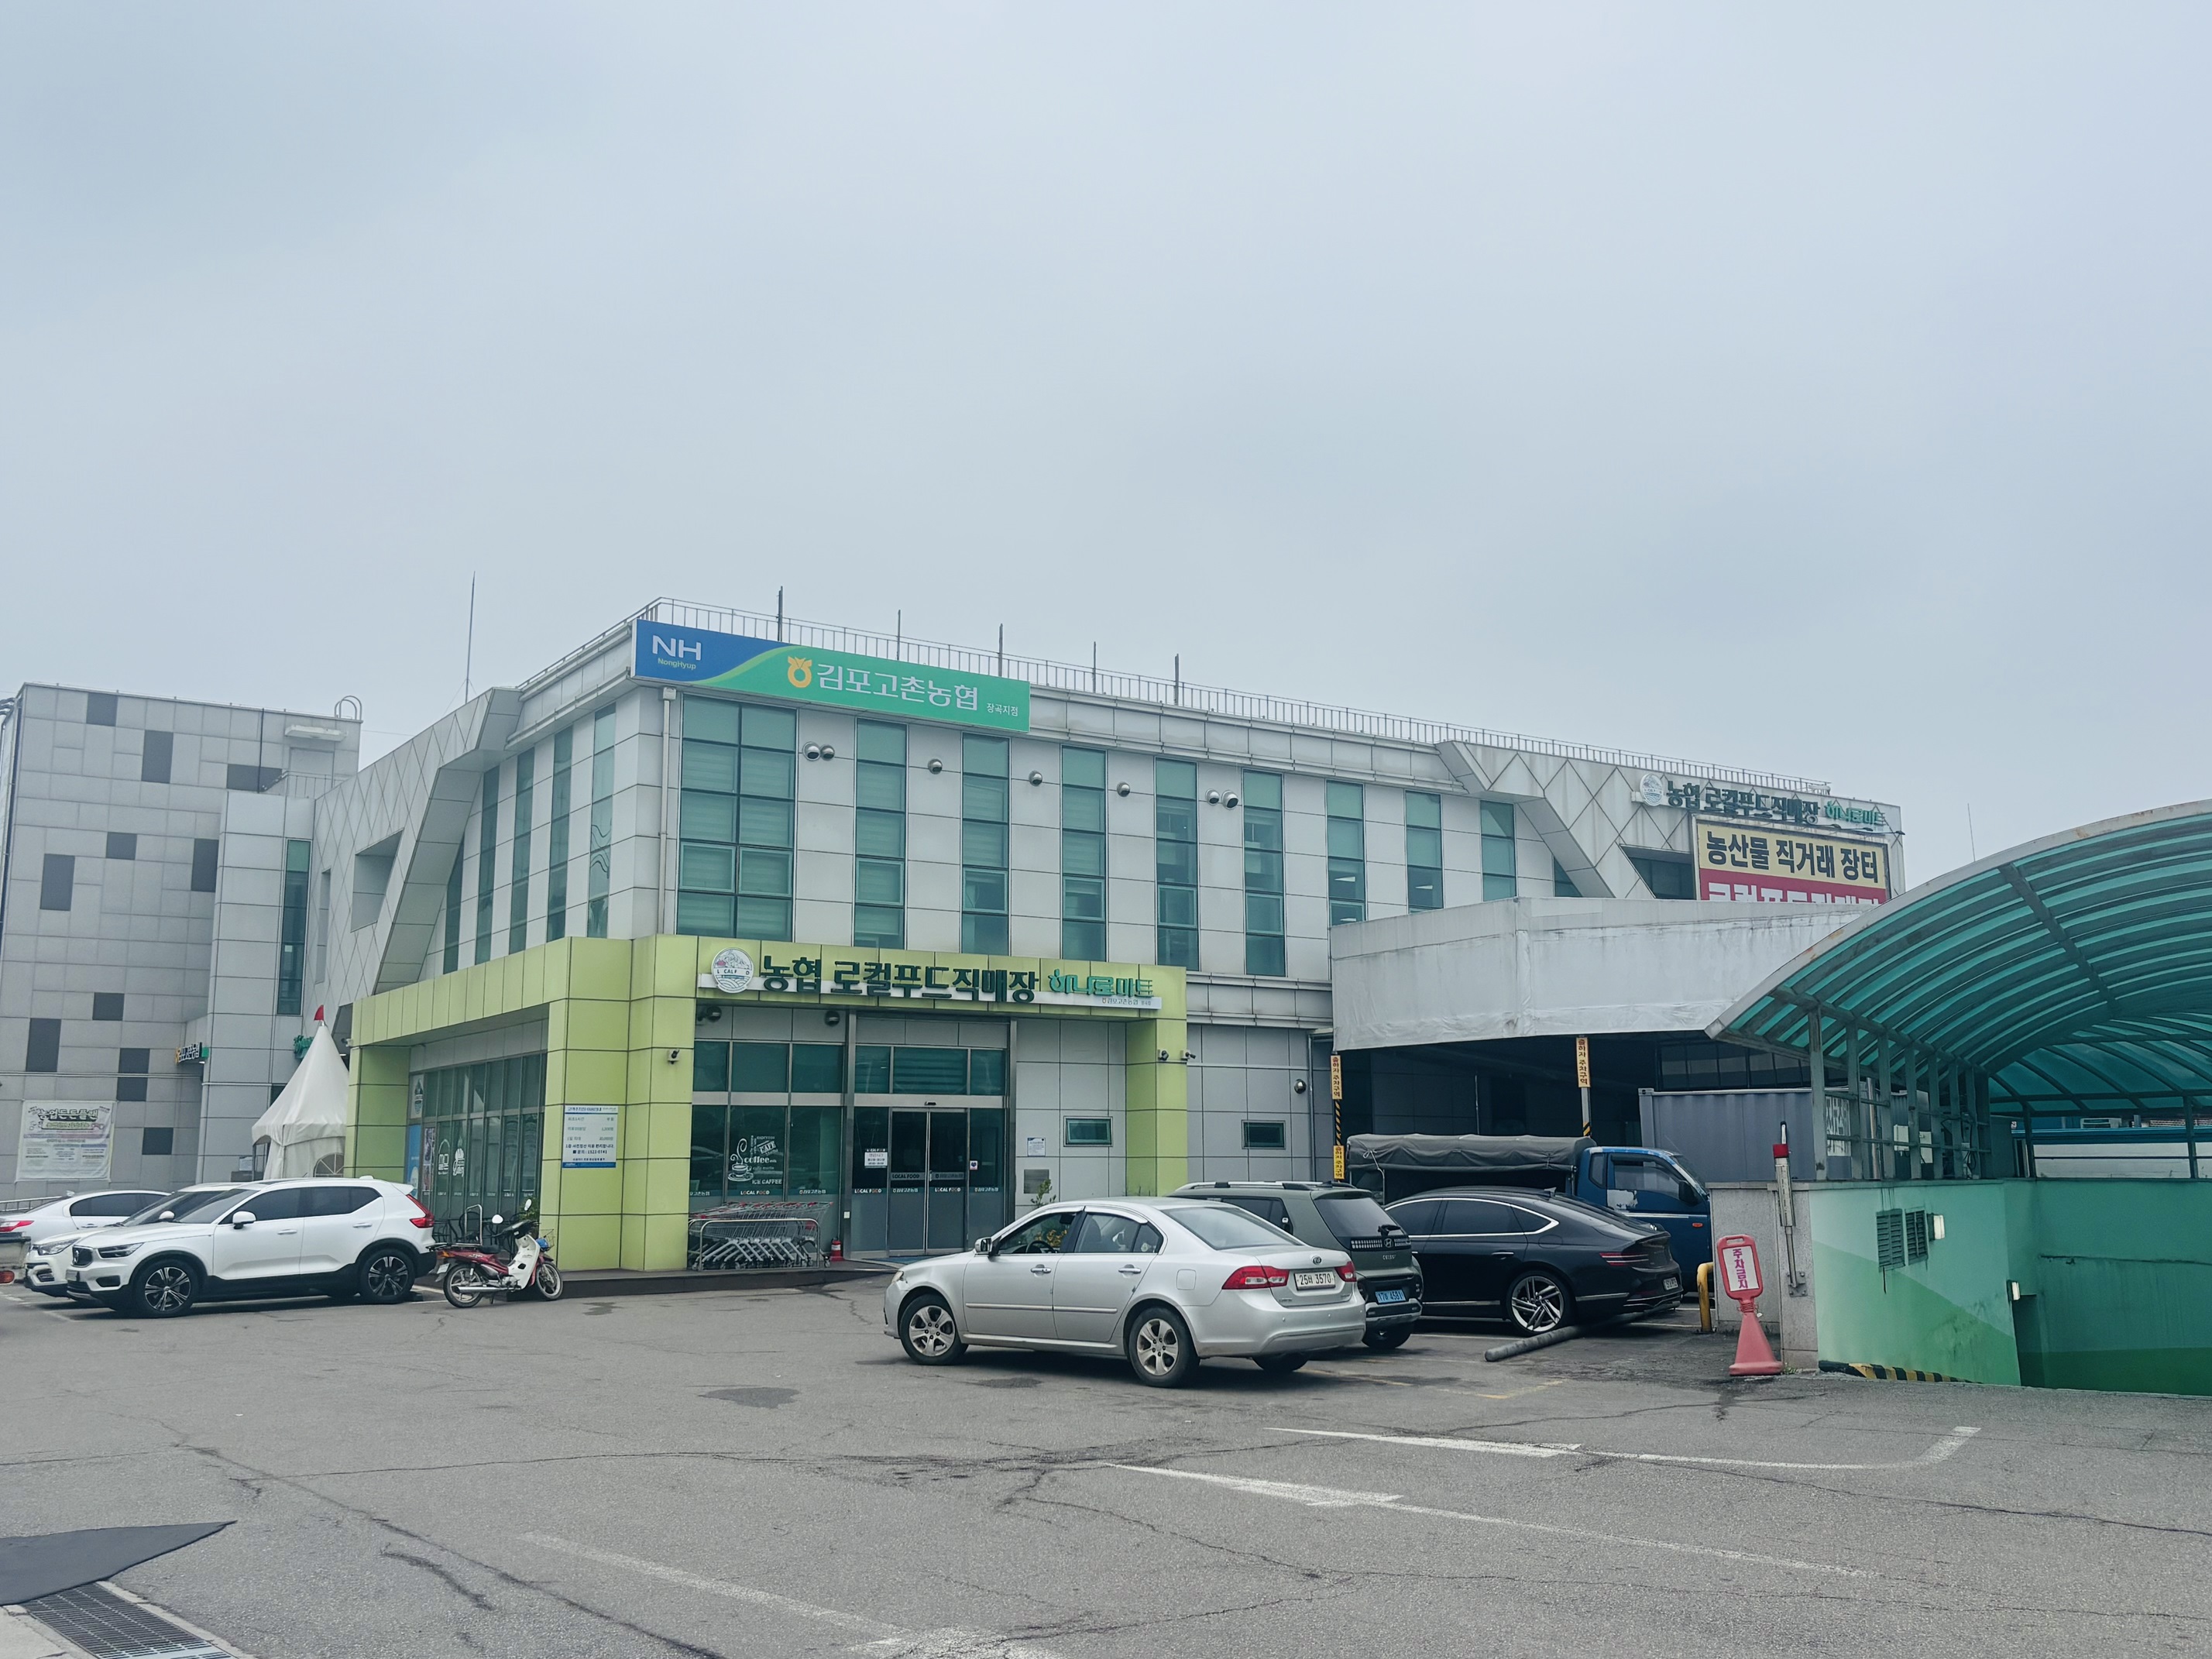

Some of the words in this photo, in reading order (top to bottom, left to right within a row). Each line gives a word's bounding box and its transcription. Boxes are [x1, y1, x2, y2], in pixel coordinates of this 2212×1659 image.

[653, 635, 702, 661] NH
[658, 658, 696, 671] NongHyup
[816, 663, 978, 711] 김포고촌농협
[987, 703, 1018, 716] 장곡지점
[1666, 781, 1701, 810] 농협
[1705, 786, 1820, 825] 로컬푸드직매장
[1824, 801, 1887, 826] 하나로마트
[1706, 831, 1770, 871] 농산물
[1776, 840, 1836, 878] 직거래
[1840, 848, 1879, 883] 장터
[760, 956, 822, 993] 농협
[834, 960, 1039, 1003] 로컬푸드직매장
[1048, 969, 1155, 998] 하나로마트
[1578, 1059, 1588, 1085] 주차구역
[1314, 1273, 1331, 1285] 3570
[1733, 1249, 1748, 1289] 주차금지
